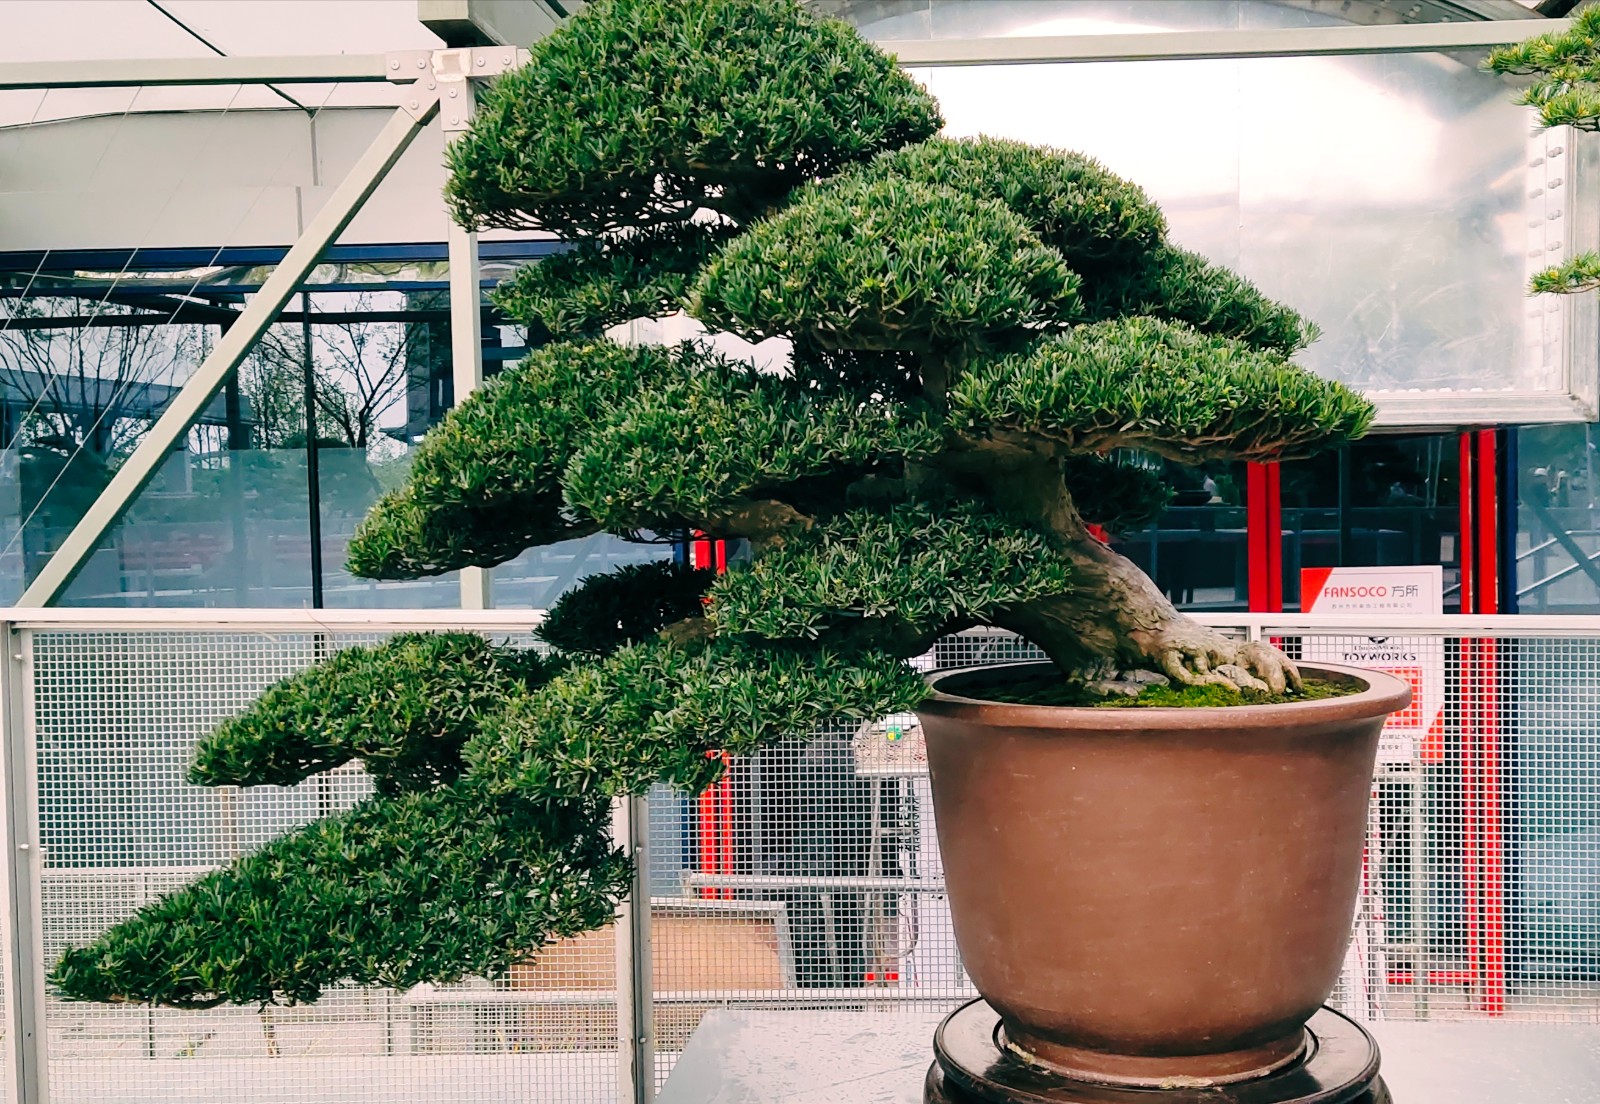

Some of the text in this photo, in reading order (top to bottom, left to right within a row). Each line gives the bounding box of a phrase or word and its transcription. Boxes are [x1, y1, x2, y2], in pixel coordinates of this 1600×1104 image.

[1324, 585, 1419, 598] FANSOCO 方所
[1342, 652, 1417, 662] TOYWORKS
